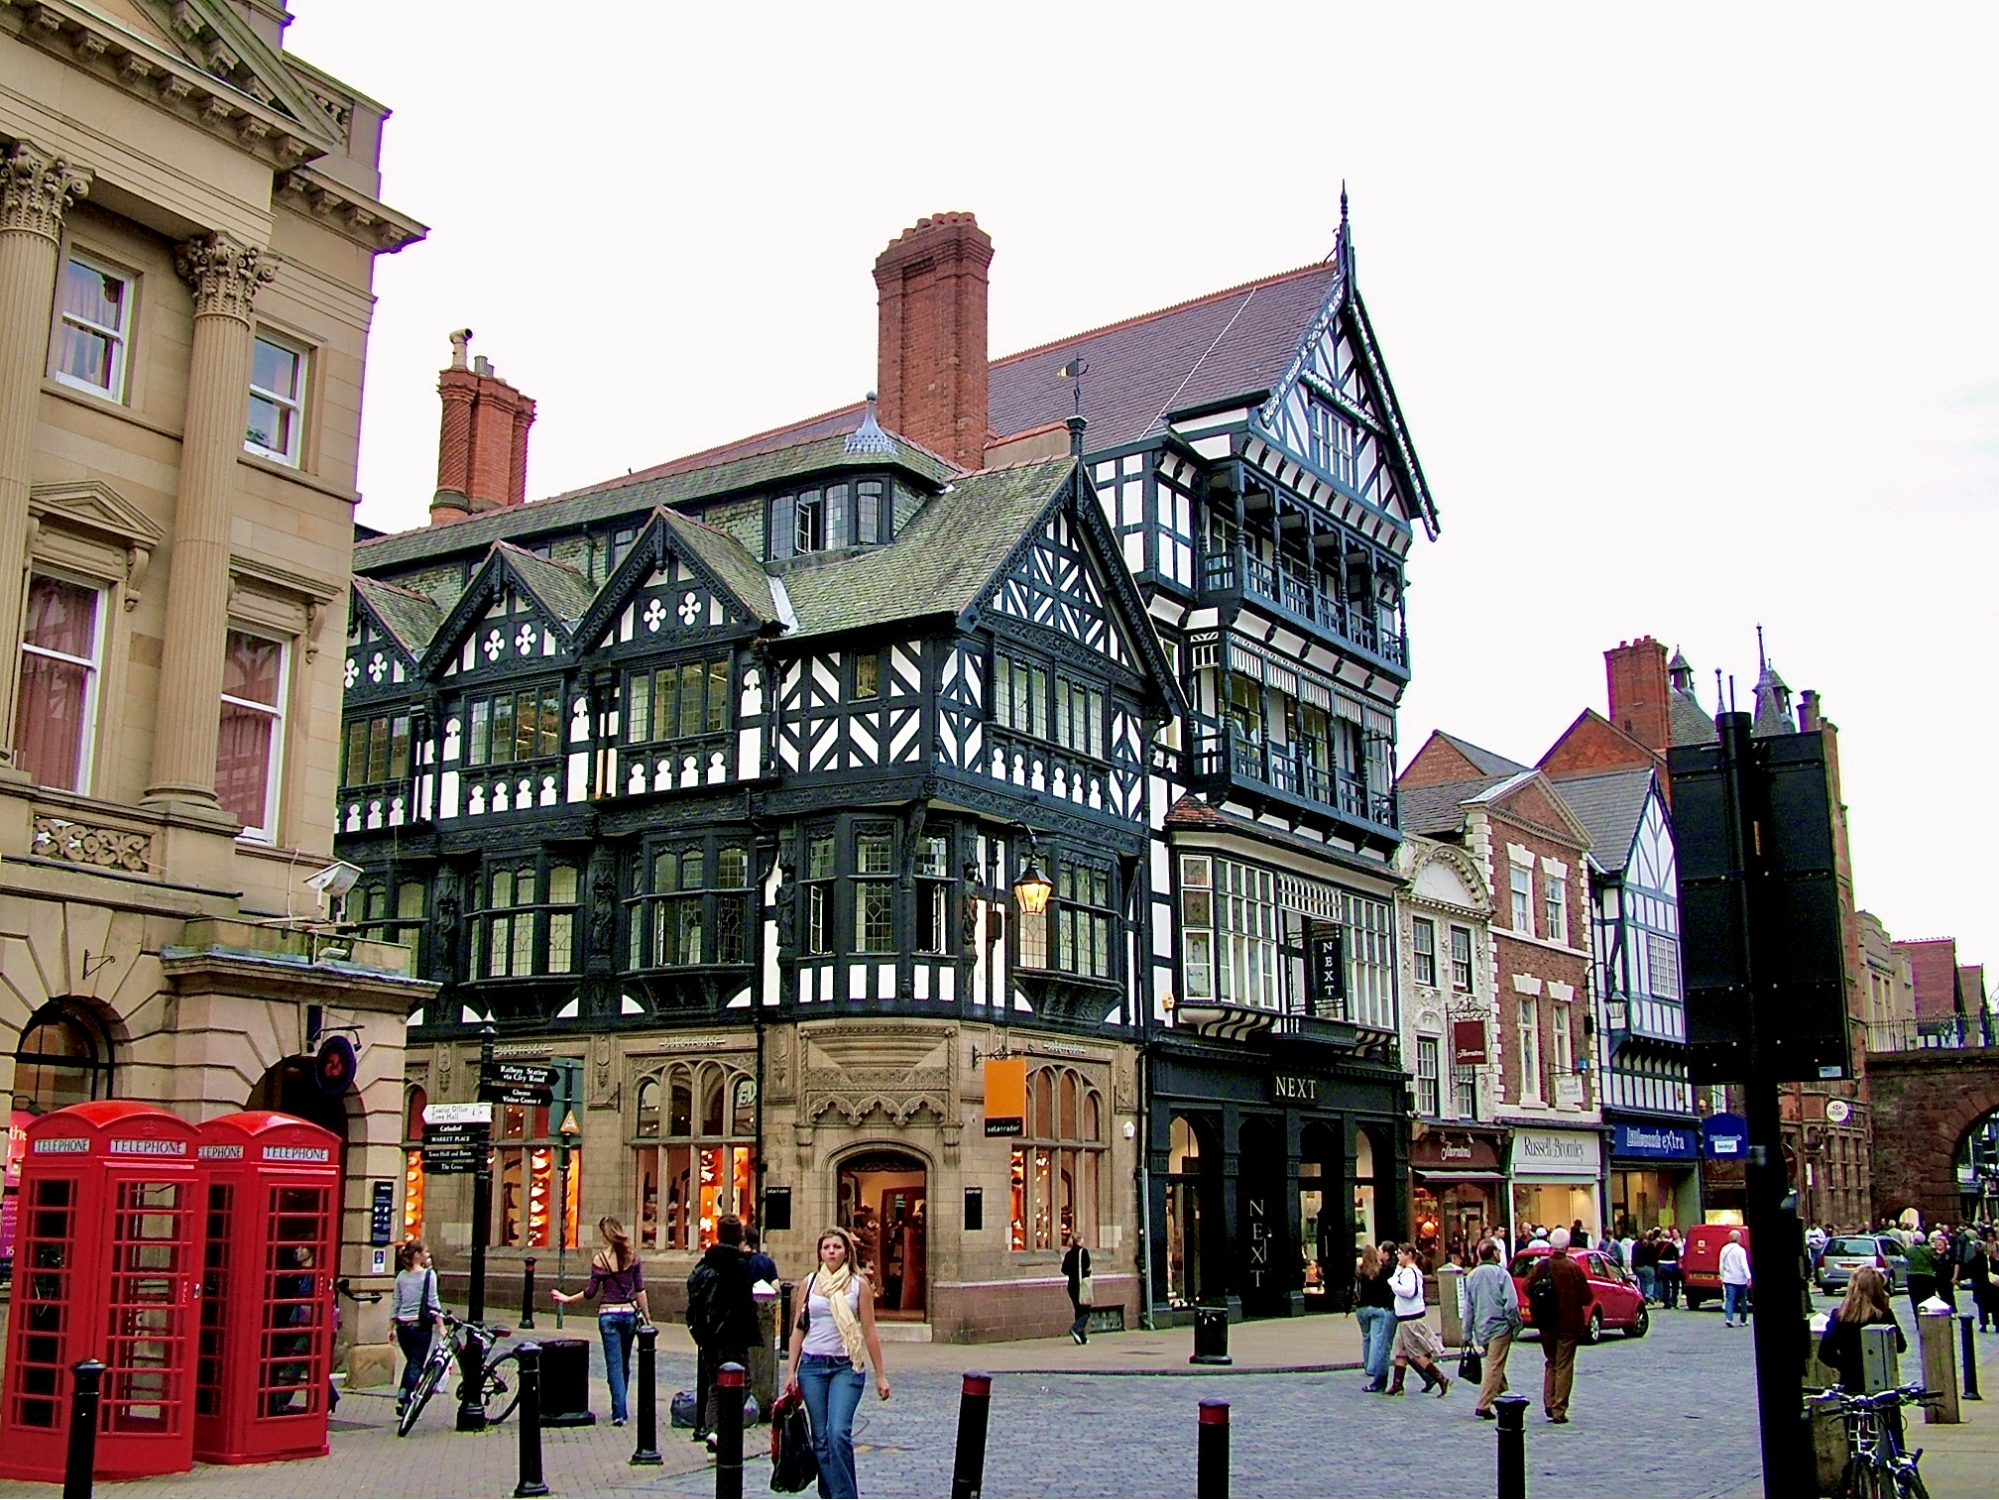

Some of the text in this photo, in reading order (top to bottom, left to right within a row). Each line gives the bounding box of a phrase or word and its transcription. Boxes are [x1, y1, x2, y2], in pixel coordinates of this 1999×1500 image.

[1323, 942, 1335, 996] NEXT
[500, 1065, 549, 1077] Railway Station
[513, 1073, 527, 1083] City
[528, 1075, 545, 1083] Road
[1275, 1076, 1317, 1099] NEXT
[37, 1139, 88, 1152] TELEPHONE
[114, 1140, 183, 1154] TELEPHONE
[1524, 1136, 1552, 1156] Russell
[1555, 1137, 1584, 1162] Bromley
[265, 1147, 326, 1160] TELEPHONE
[1249, 1200, 1265, 1287] NEXT
